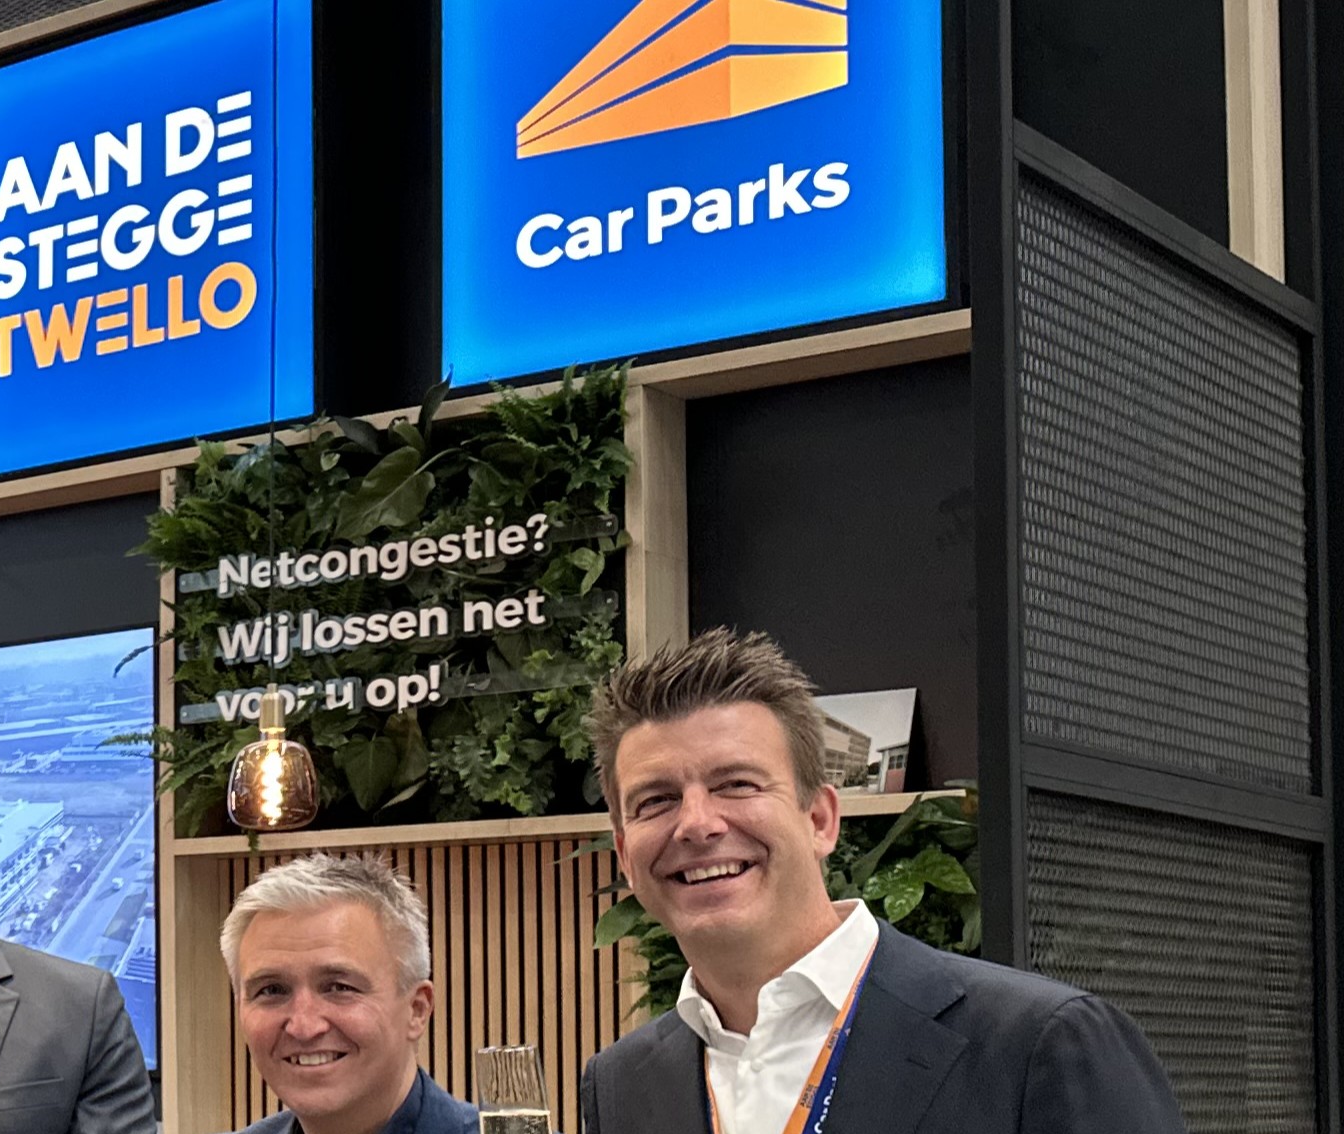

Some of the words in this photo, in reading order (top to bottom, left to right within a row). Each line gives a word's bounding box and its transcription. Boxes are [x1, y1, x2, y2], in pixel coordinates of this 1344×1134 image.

[165, 90, 252, 177] DE
[516, 207, 634, 269] Car
[647, 162, 851, 244] Parks
[218, 513, 549, 594] Netcongestie?
[218, 614, 289, 664] Wij
[302, 604, 448, 650] lossen
[463, 589, 546, 633] net
[365, 664, 442, 714] op!
